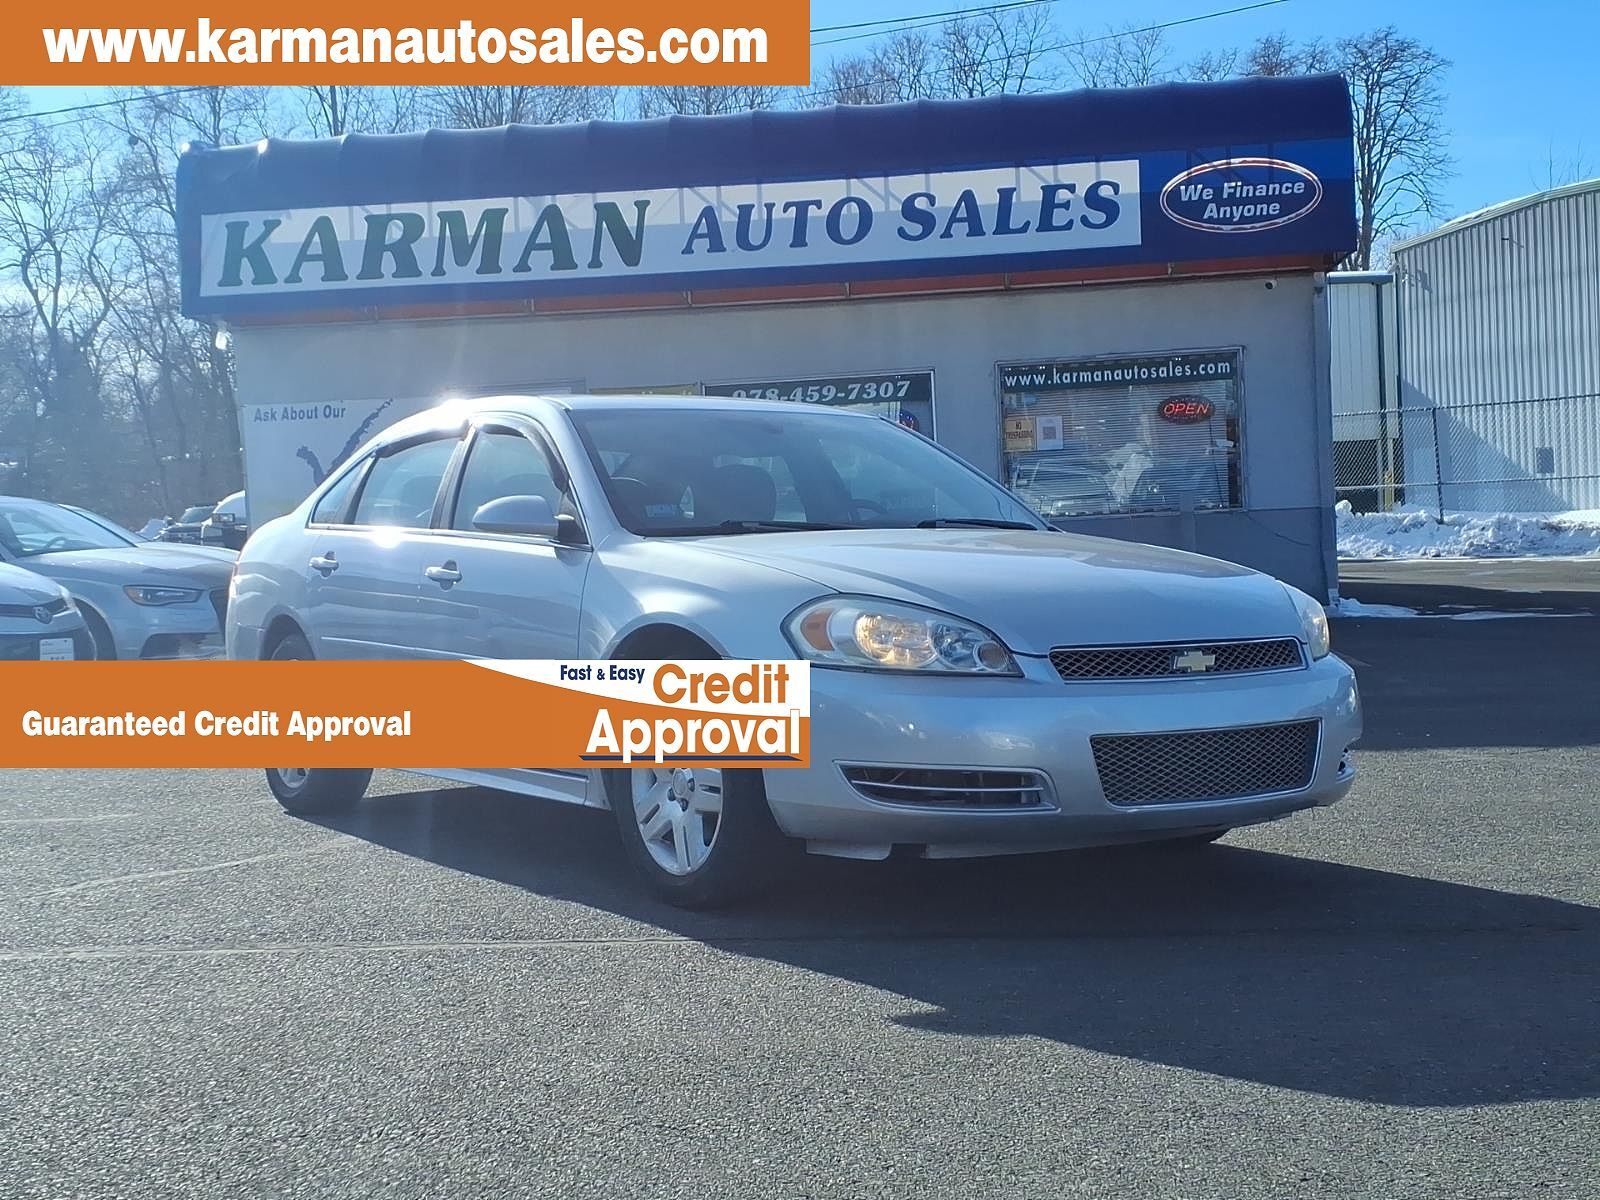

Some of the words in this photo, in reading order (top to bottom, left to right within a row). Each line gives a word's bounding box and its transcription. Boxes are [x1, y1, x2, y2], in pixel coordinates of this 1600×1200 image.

[1180, 184, 1214, 202] We
[1222, 181, 1305, 199] Finance
[1202, 202, 1281, 222] Anyone
[217, 199, 650, 287] KARMAN
[681, 195, 874, 255] AUTO
[897, 179, 1122, 242] SALES
[1004, 361, 1231, 387] www.karmanautosales.com
[254, 407, 278, 423] Ask
[281, 406, 318, 421] About
[323, 404, 346, 419] Our
[1163, 402, 1210, 415] OPEN
